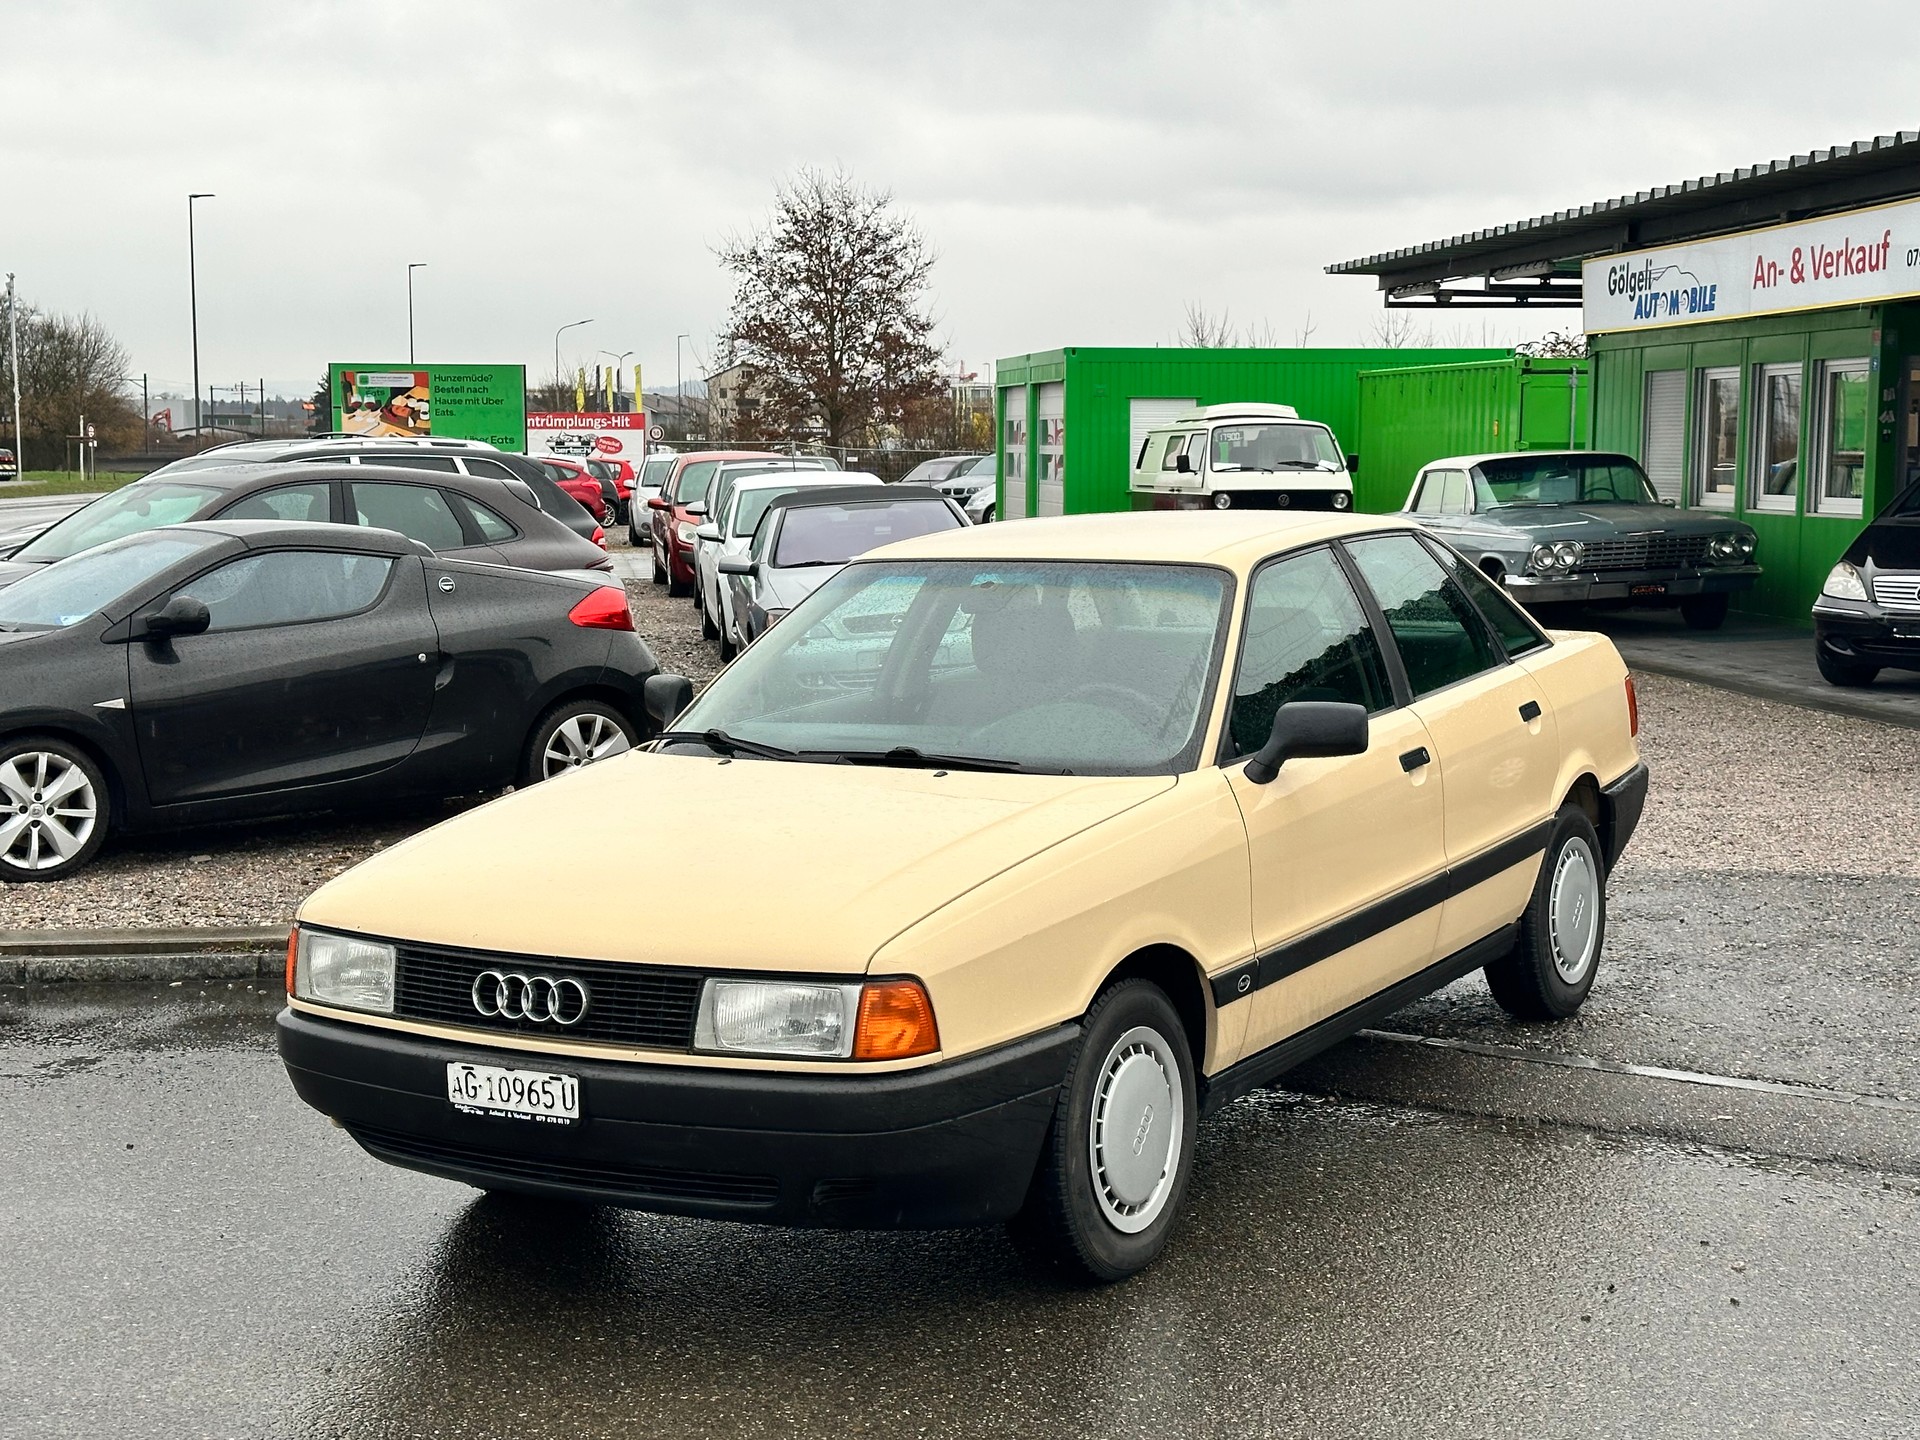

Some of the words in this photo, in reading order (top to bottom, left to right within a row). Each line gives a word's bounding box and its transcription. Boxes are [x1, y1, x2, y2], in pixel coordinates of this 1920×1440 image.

[1753, 255, 1785, 290] An-
[1790, 246, 1805, 285] &
[1810, 229, 1891, 281] Verkauf
[1906, 248, 1920, 267] 07
[1608, 258, 1653, 302] Gölgeli
[1633, 284, 1717, 320] AUTOMOBILE
[433, 373, 493, 382] Hunzemüde?
[434, 385, 465, 394] Bestell
[466, 385, 489, 394] nach
[434, 397, 463, 405] Hause
[465, 397, 480, 405] mit
[481, 397, 504, 405] Uber
[434, 408, 456, 416] Eats.
[527, 414, 631, 430] ntrümplungs-Hit
[490, 435, 515, 444] Eats
